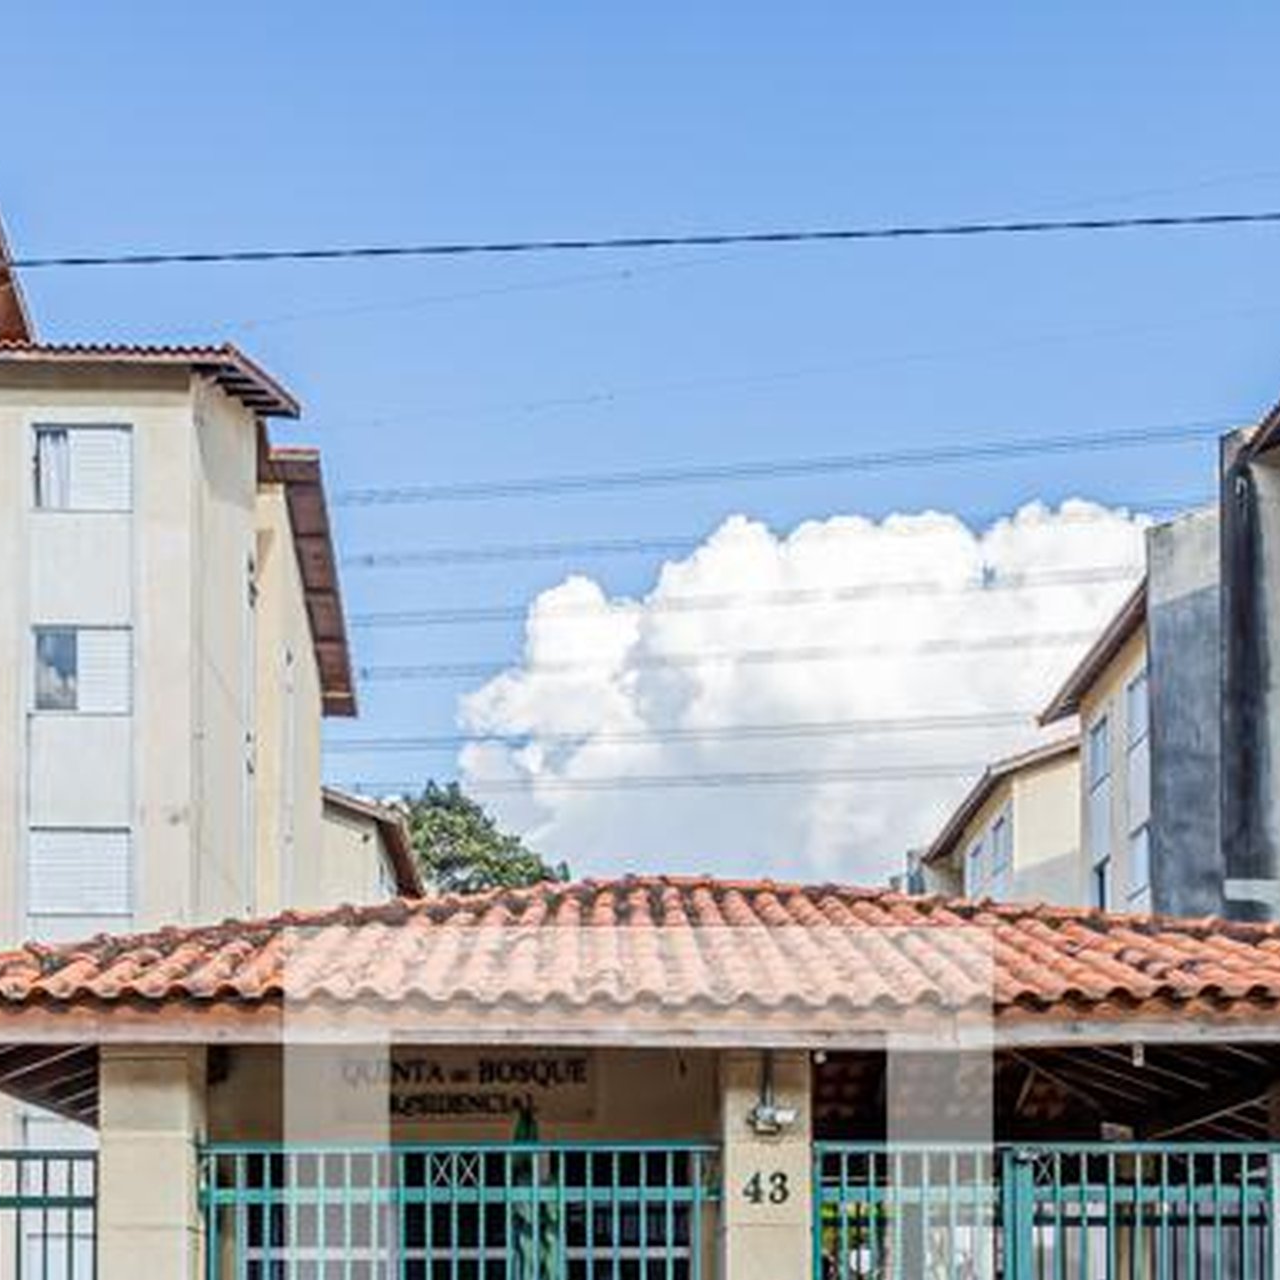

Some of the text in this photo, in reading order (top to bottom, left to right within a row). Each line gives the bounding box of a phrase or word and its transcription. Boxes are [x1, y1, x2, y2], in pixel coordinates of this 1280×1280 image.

[341, 1058, 445, 1087] QUINTA
[477, 1057, 588, 1085] BOSQUE
[742, 1171, 790, 1204] 43
